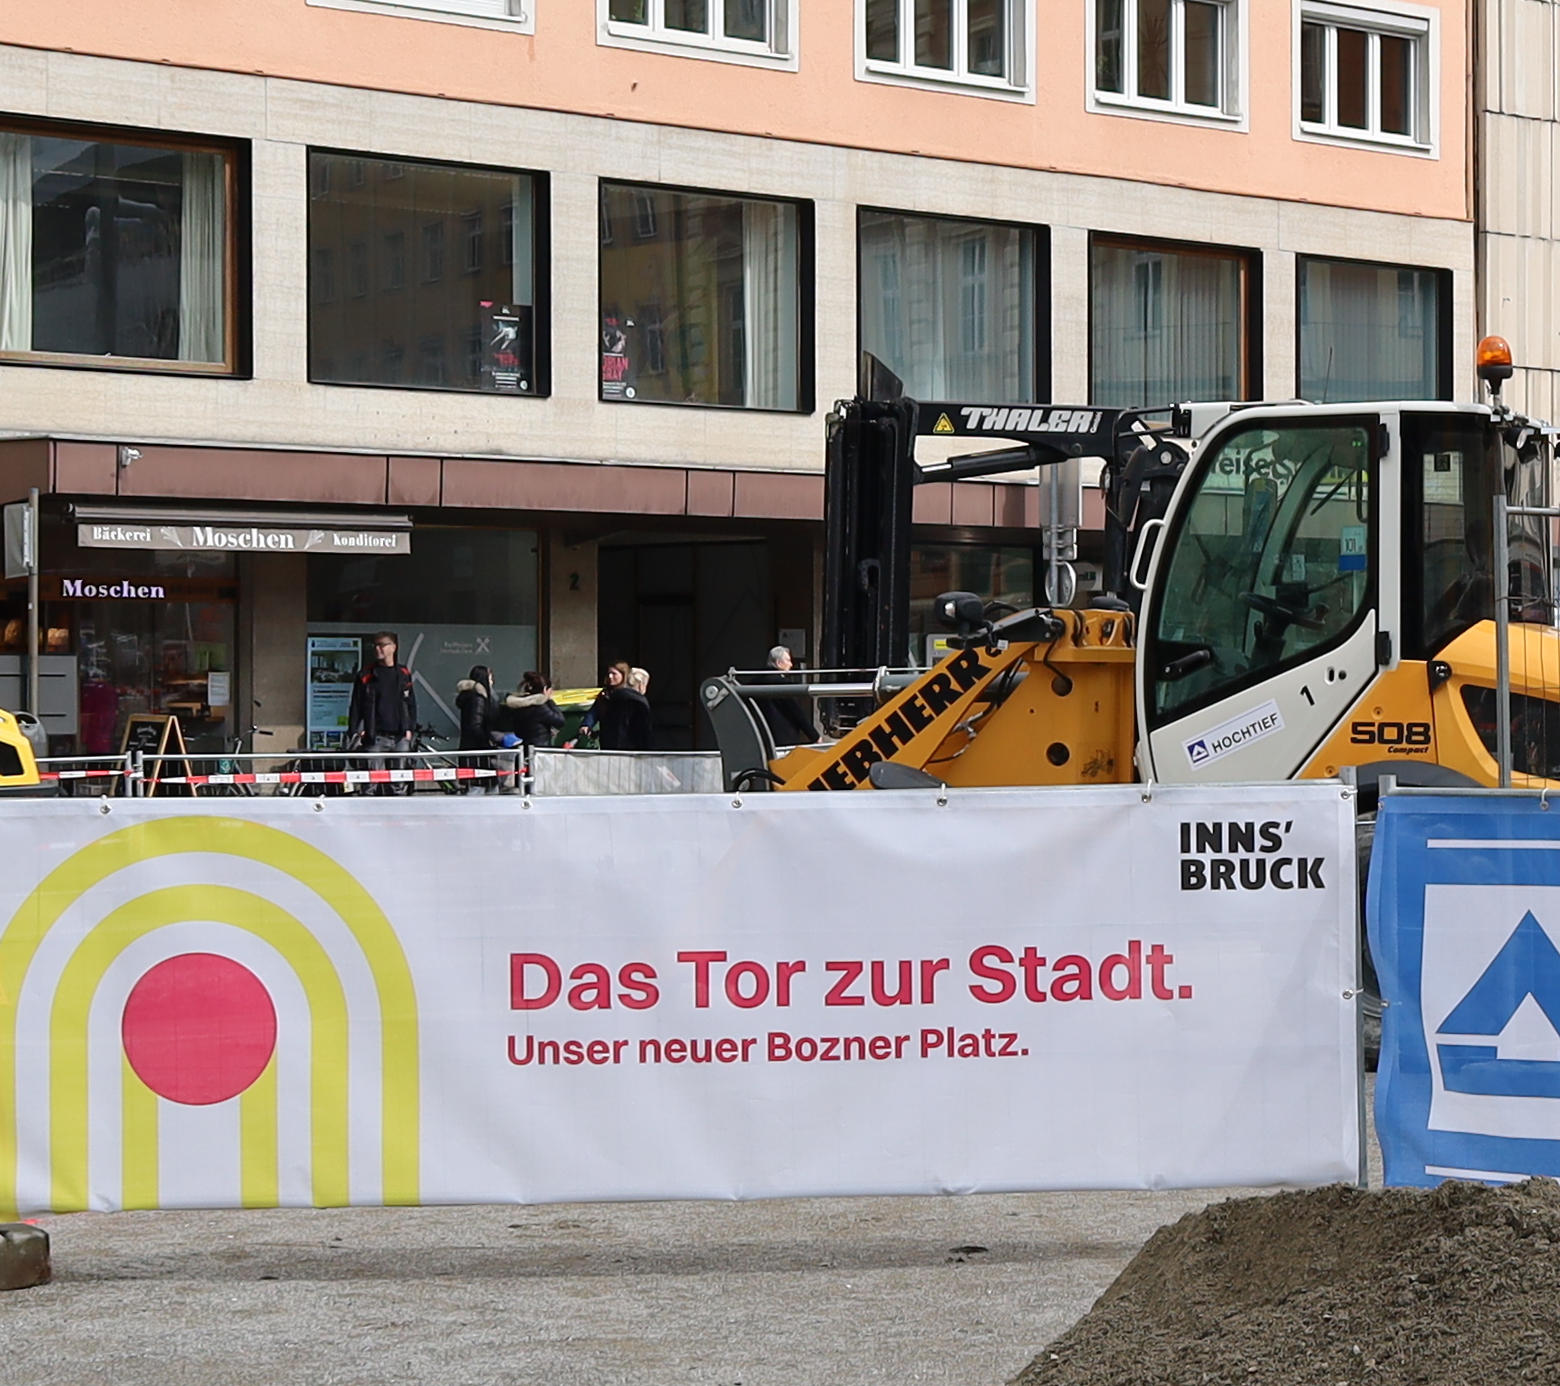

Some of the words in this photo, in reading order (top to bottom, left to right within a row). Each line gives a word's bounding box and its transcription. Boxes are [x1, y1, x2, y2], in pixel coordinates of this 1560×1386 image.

[960, 406, 1093, 433] THALER
[92, 526, 152, 543] Bäckerei
[192, 525, 295, 551] Moschen
[61, 578, 166, 600] Moschen
[1299, 684, 1316, 706] 1
[1211, 711, 1279, 754] HOCHTIEF
[1349, 721, 1432, 746] 508
[1386, 745, 1430, 756] Compact
[1178, 856, 1326, 893] BRUCK
[507, 951, 661, 1012] Das
[676, 949, 806, 1010] Tor
[823, 956, 951, 1009] zur
[967, 938, 1195, 1005] Stadt.
[506, 1033, 629, 1067] Unser
[638, 1032, 758, 1066] neuer
[766, 1029, 911, 1064] Bozner
[919, 1025, 1031, 1062] Platz.
